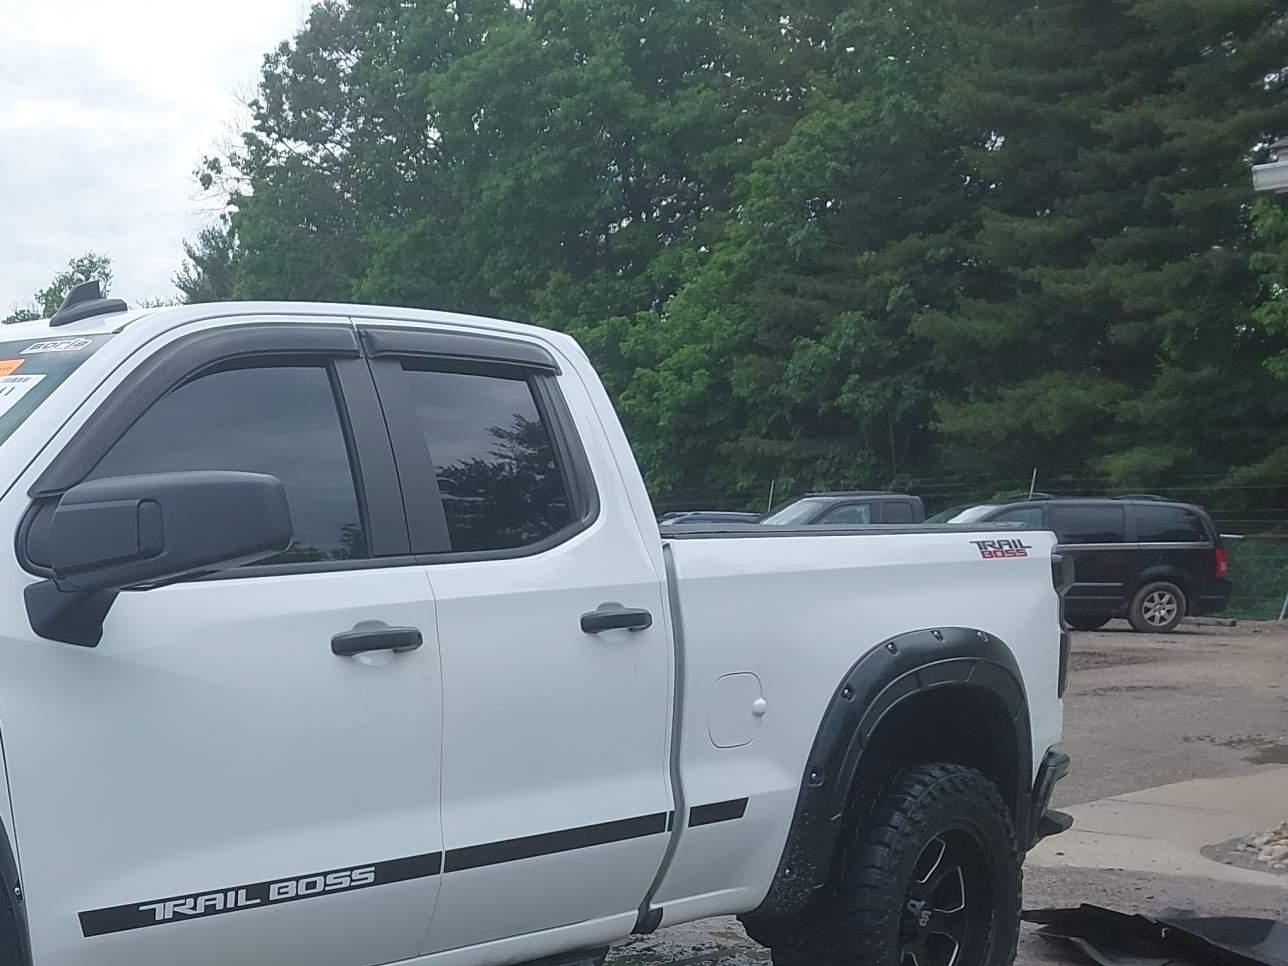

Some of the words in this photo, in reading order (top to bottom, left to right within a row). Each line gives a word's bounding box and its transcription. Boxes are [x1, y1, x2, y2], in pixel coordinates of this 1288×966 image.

[969, 539, 1032, 550] TRAIL
[981, 549, 1028, 559] BOSS
[139, 889, 261, 920] TRAIL
[269, 866, 375, 901] BOSS
